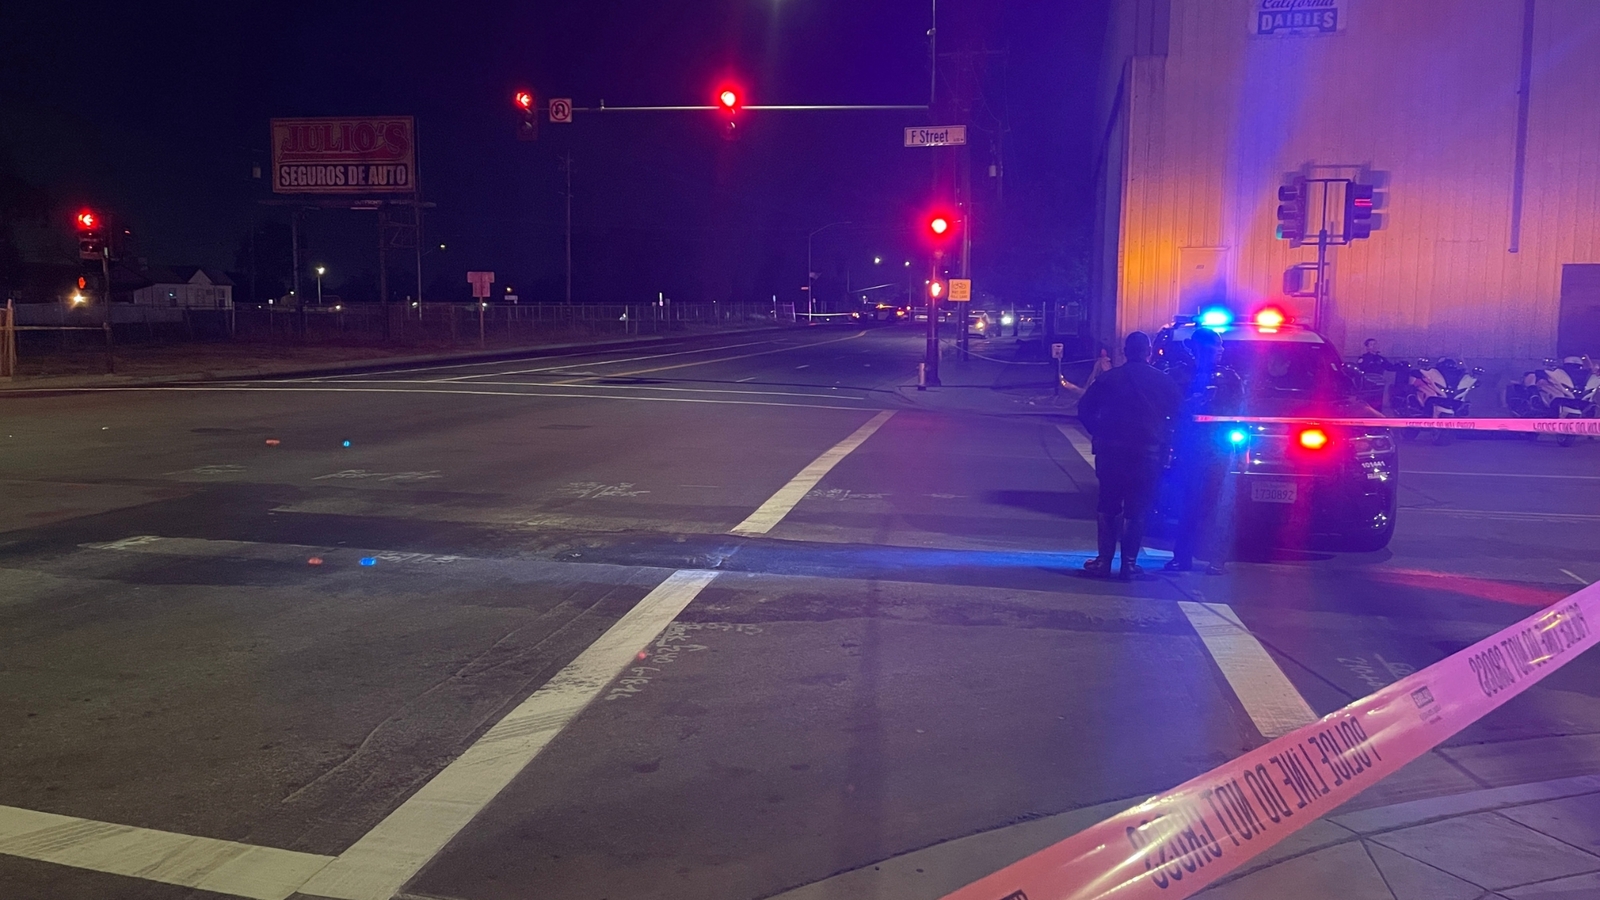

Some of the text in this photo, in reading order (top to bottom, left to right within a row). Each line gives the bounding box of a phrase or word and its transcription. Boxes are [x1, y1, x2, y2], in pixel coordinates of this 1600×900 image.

[1261, 11, 1334, 31] DAIRIES
[281, 121, 410, 154] JULIO'S
[911, 129, 949, 143] F Street
[280, 165, 407, 186] SEGUROS DE AUTO
